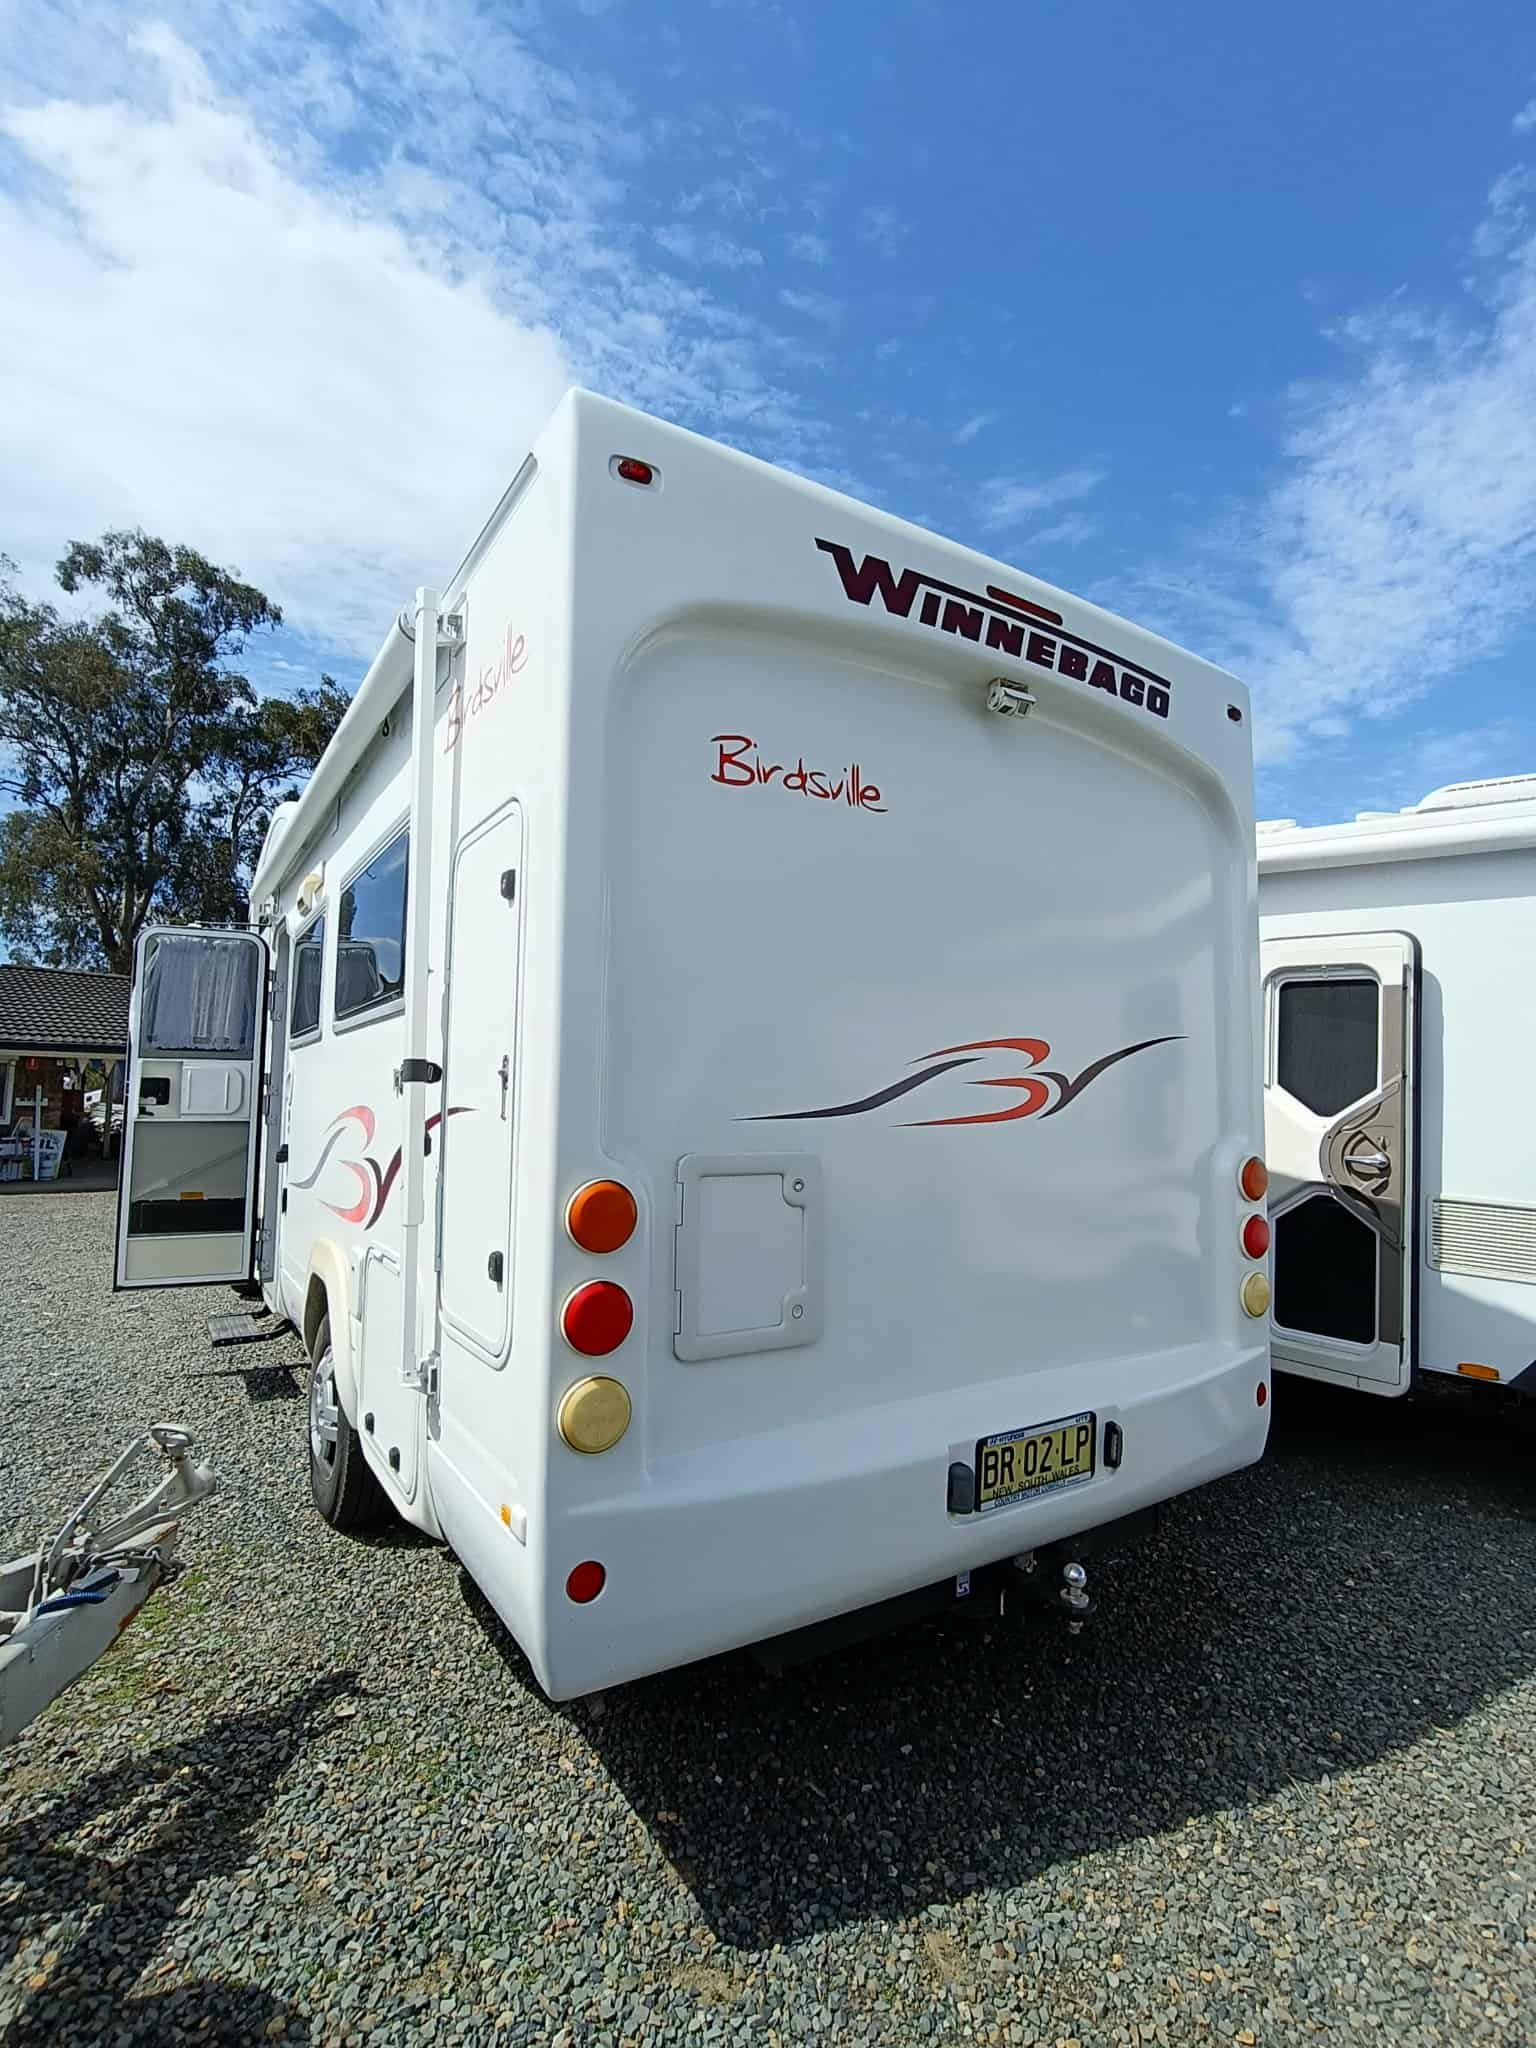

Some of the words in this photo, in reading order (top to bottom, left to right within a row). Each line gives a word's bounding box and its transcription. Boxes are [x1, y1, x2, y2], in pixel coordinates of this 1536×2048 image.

[815, 538, 1171, 719] WINNEBAGO
[711, 735, 889, 812] Birdsville
[992, 1484, 1014, 1498] NEW
[1018, 1474, 1048, 1492] SOUTH
[1052, 1464, 1080, 1481] WALES
